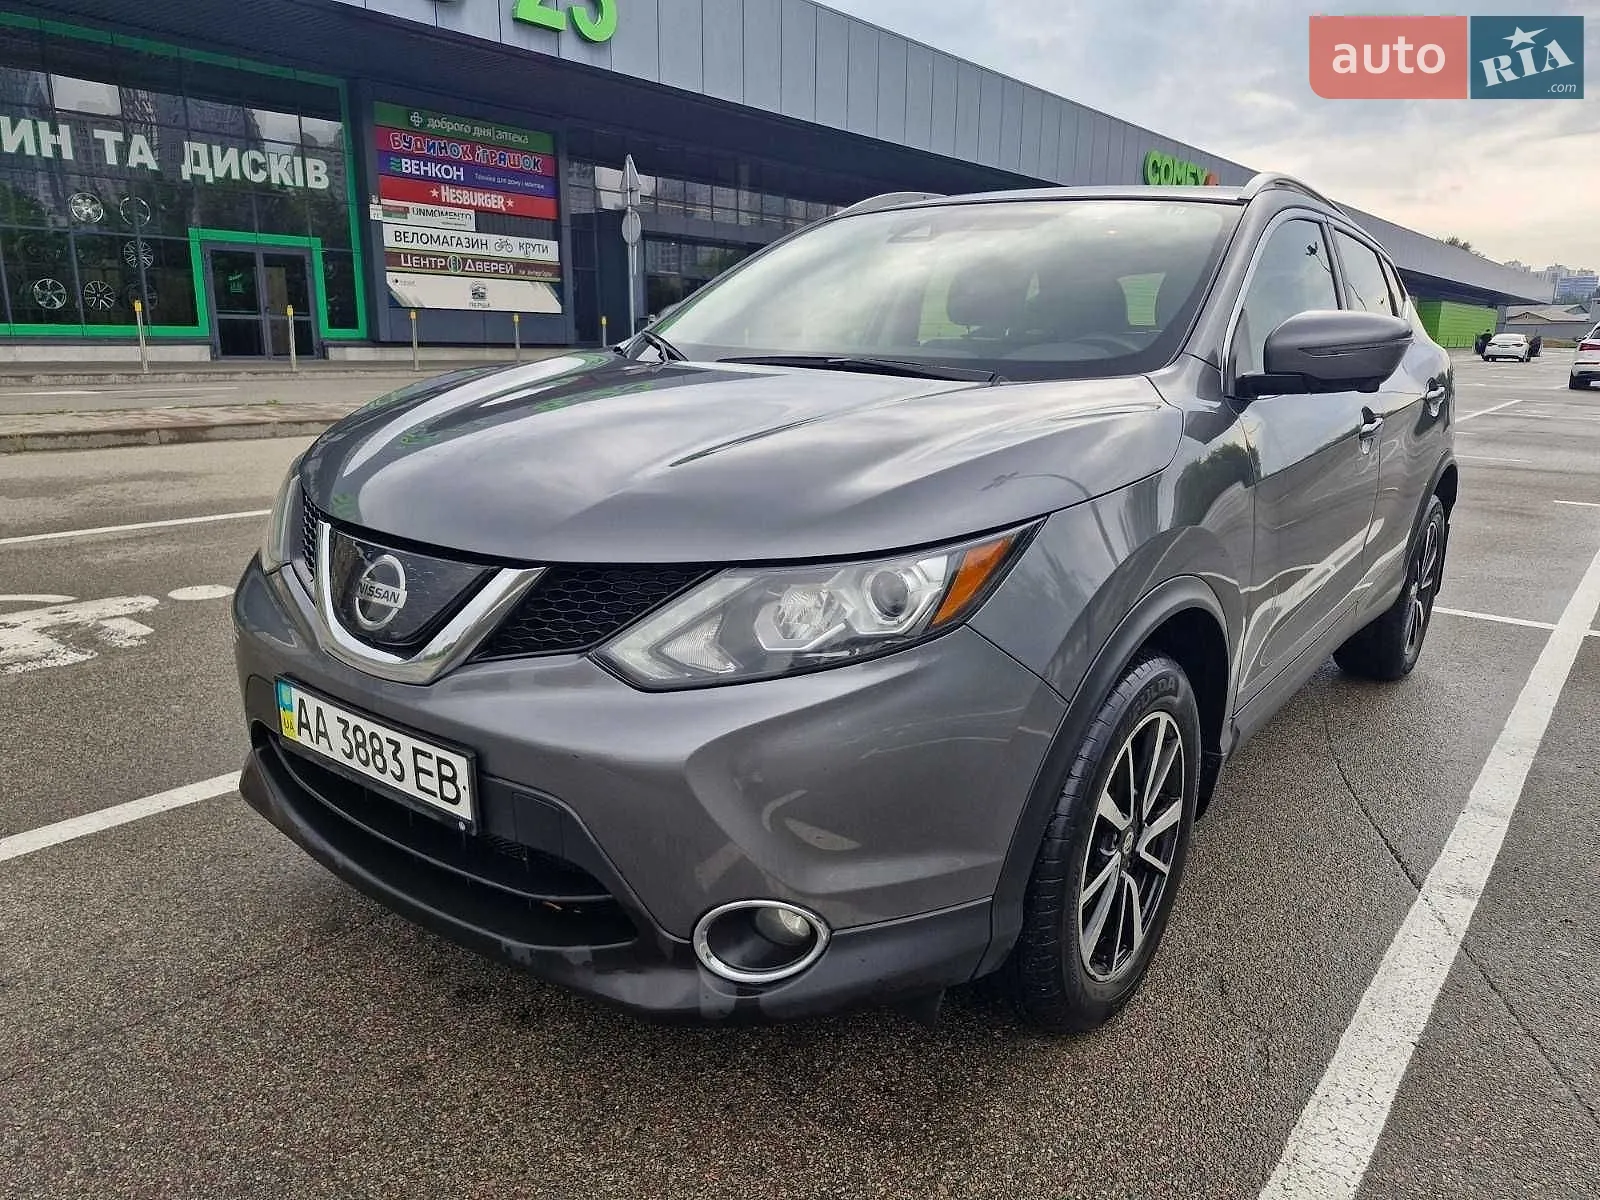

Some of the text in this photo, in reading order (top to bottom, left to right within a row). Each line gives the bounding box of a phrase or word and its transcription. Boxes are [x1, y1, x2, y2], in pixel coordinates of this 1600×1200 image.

[427, 117, 471, 133] доброго
[93, 129, 159, 171] ТА
[181, 141, 329, 190] ДИСКІВ
[390, 132, 472, 161] БУДИНОК
[402, 158, 464, 181] ВЕНКОН
[441, 185, 506, 211] HESBURGER
[394, 230, 549, 256] ВЕЛОМАГАЗИН КРУТИ
[400, 253, 446, 269] ЦЕНТР
[464, 260, 514, 274] ДВЕРЕЙ
[358, 582, 400, 604] NISSAN
[297, 698, 461, 806] AA 3883 EB
